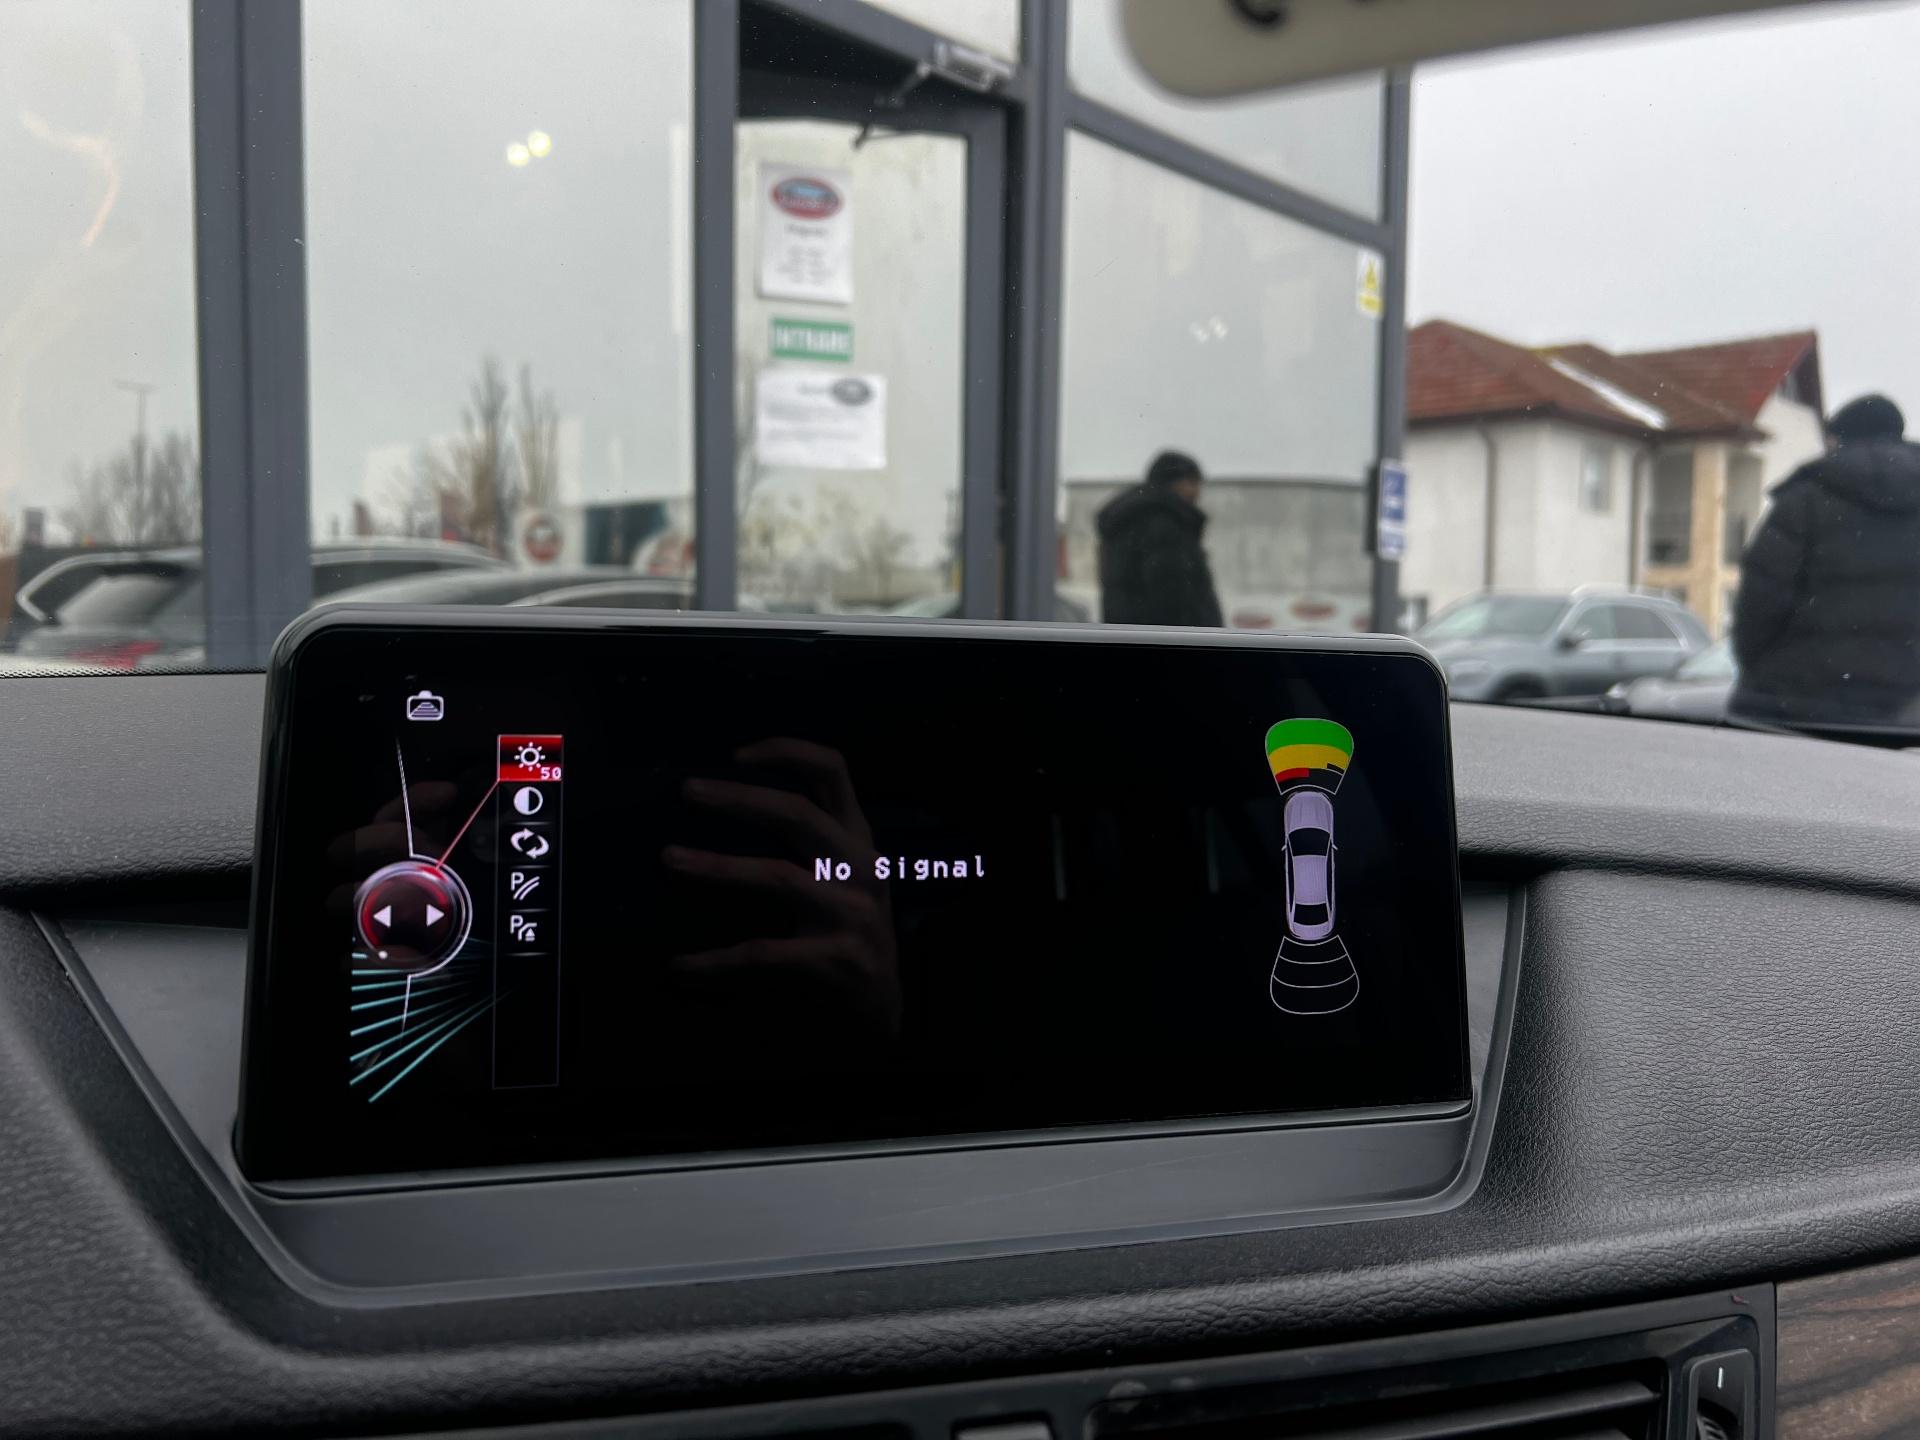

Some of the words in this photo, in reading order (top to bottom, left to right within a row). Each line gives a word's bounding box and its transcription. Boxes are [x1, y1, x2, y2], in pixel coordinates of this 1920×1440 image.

[540, 766, 562, 780] 50
[814, 857, 852, 881] No
[874, 855, 985, 881] Signal
